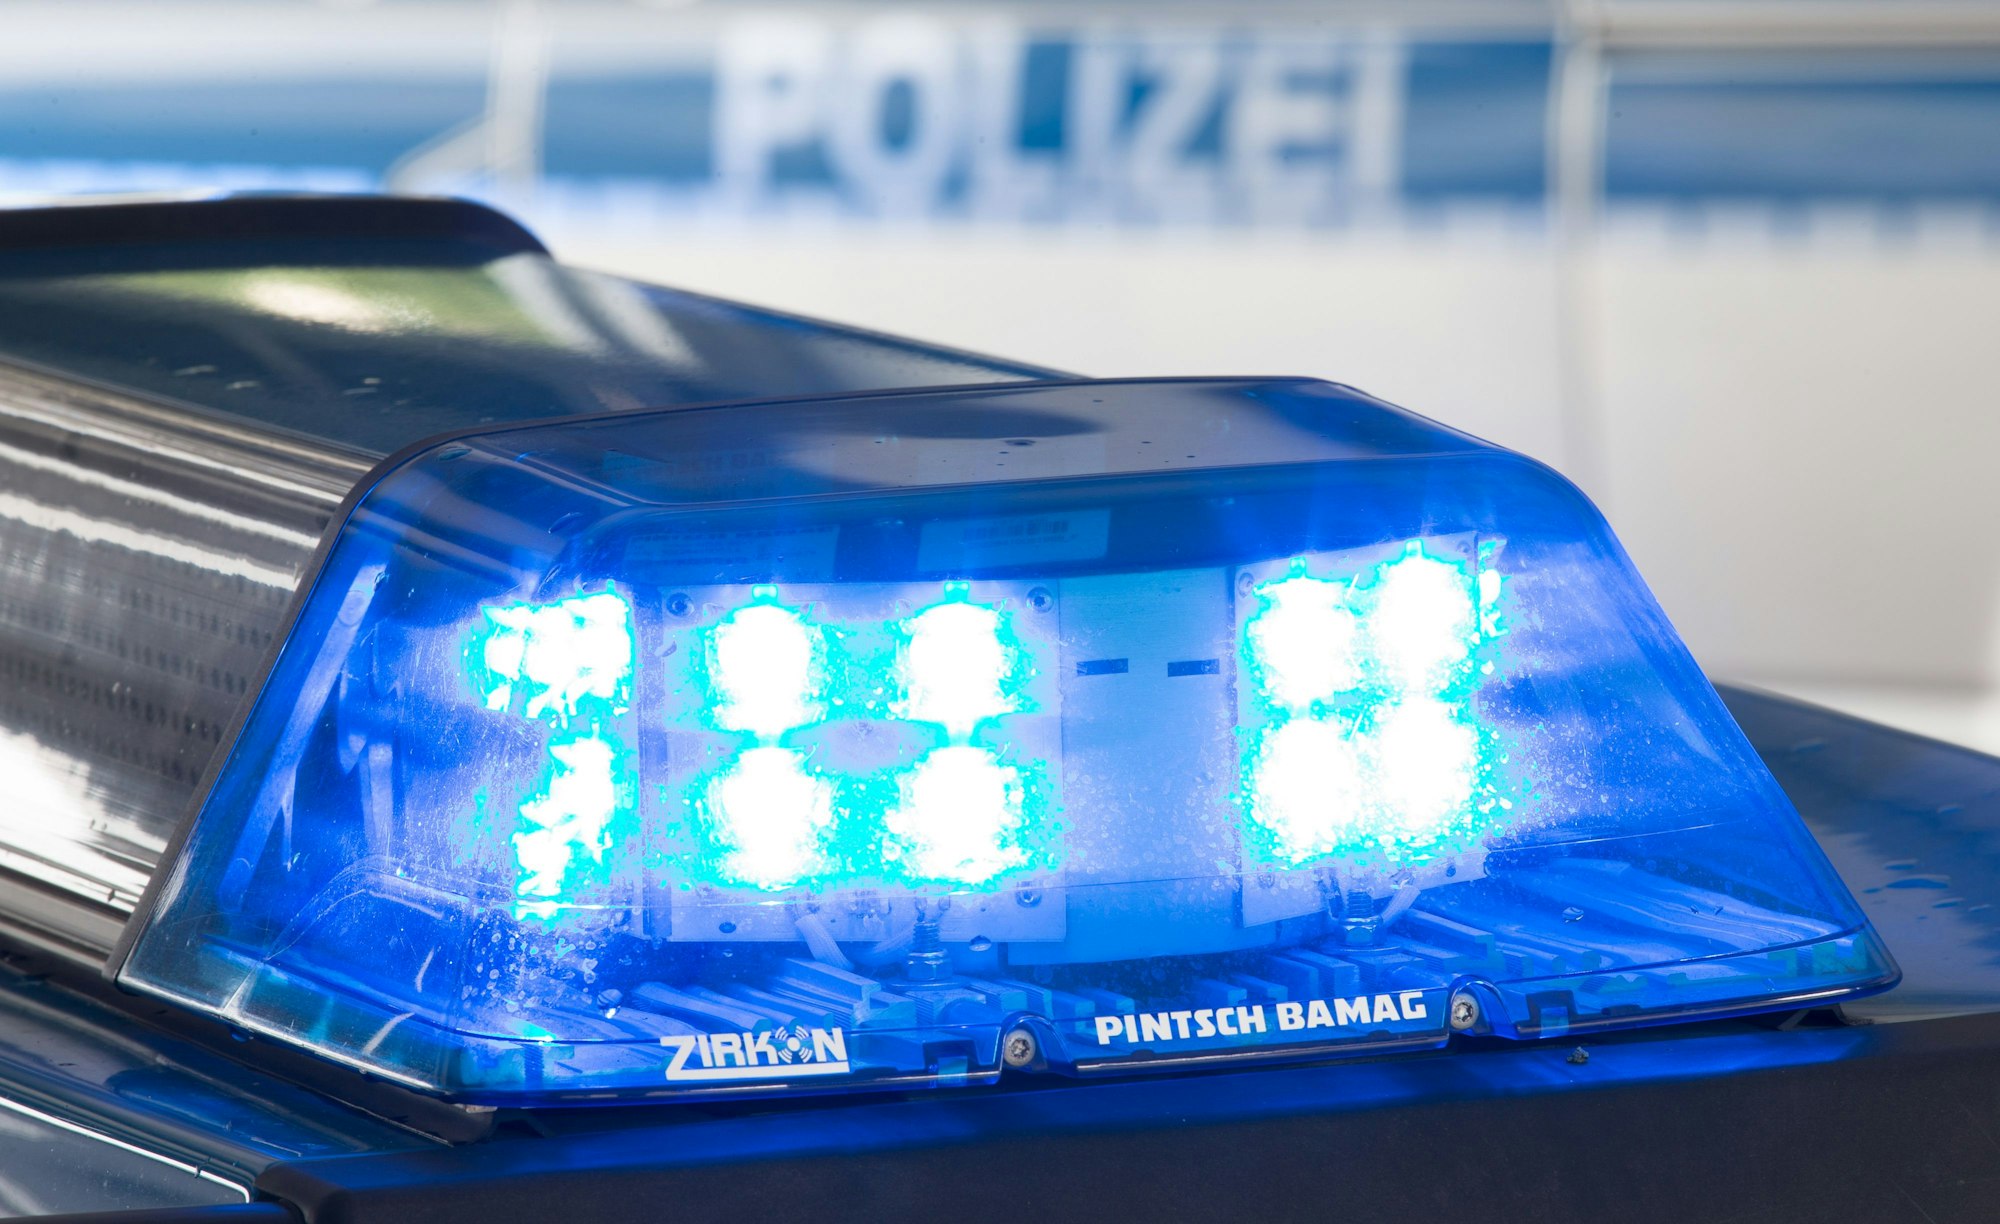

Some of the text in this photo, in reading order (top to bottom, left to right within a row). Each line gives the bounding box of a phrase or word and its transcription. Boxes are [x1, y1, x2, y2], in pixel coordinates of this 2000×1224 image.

[712, 18, 1406, 206] POLIZEI
[1094, 991, 1427, 1045] PINTSCH BAMAG
[660, 1026, 850, 1080] ZIRKON
